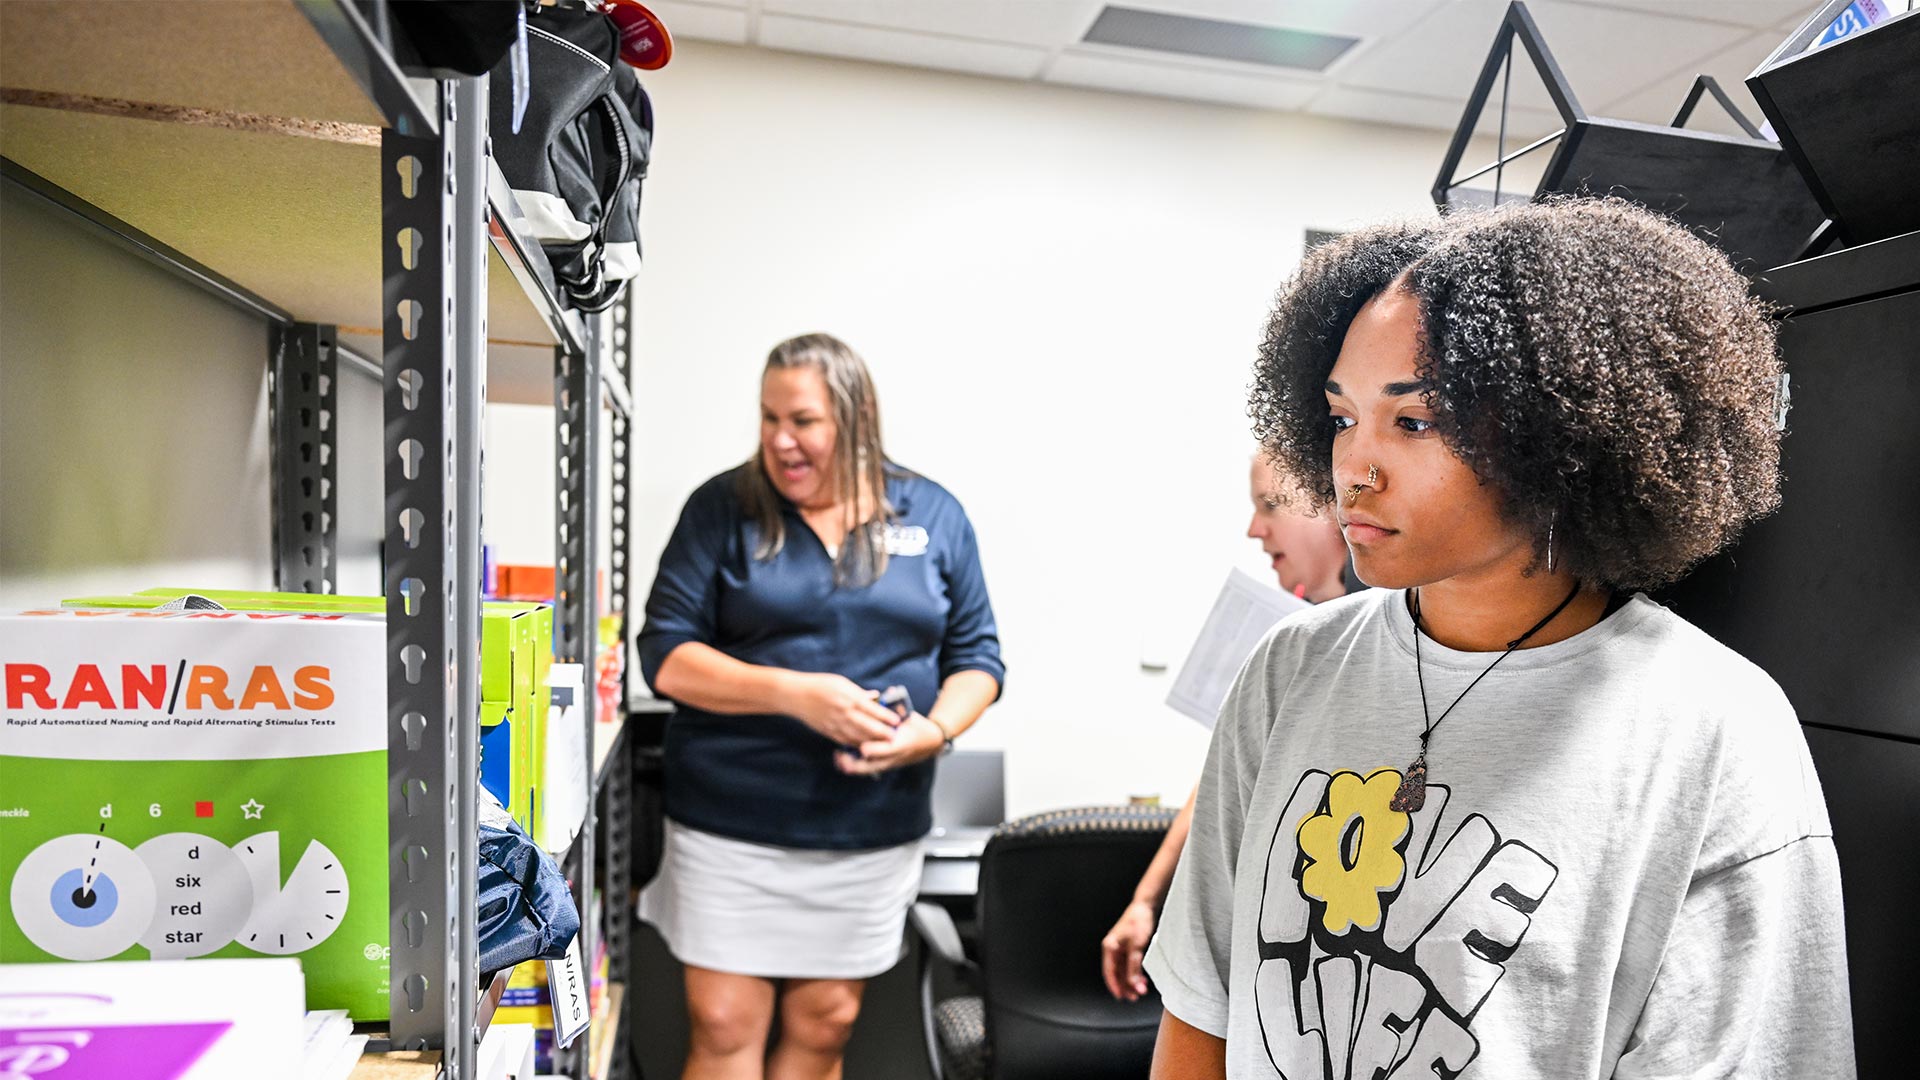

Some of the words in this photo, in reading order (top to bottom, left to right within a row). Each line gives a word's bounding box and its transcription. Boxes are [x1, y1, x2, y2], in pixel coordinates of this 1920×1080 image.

[4, 658, 336, 715] RAN/RAS
[6, 718, 38, 728] Rapid
[40, 718, 108, 728] Automatized
[110, 718, 149, 728] Naming
[151, 718, 173, 728] and
[173, 718, 203, 728] Rapid
[205, 718, 263, 728] Alternating
[265, 718, 309, 728] Stimulus
[311, 718, 336, 728] Tests
[99, 803, 113, 819] d
[148, 803, 162, 819] 6
[188, 845, 200, 860] d
[175, 873, 201, 888] six
[1258, 765, 1560, 1024] LOVE
[170, 901, 202, 916] red
[165, 930, 204, 944] star
